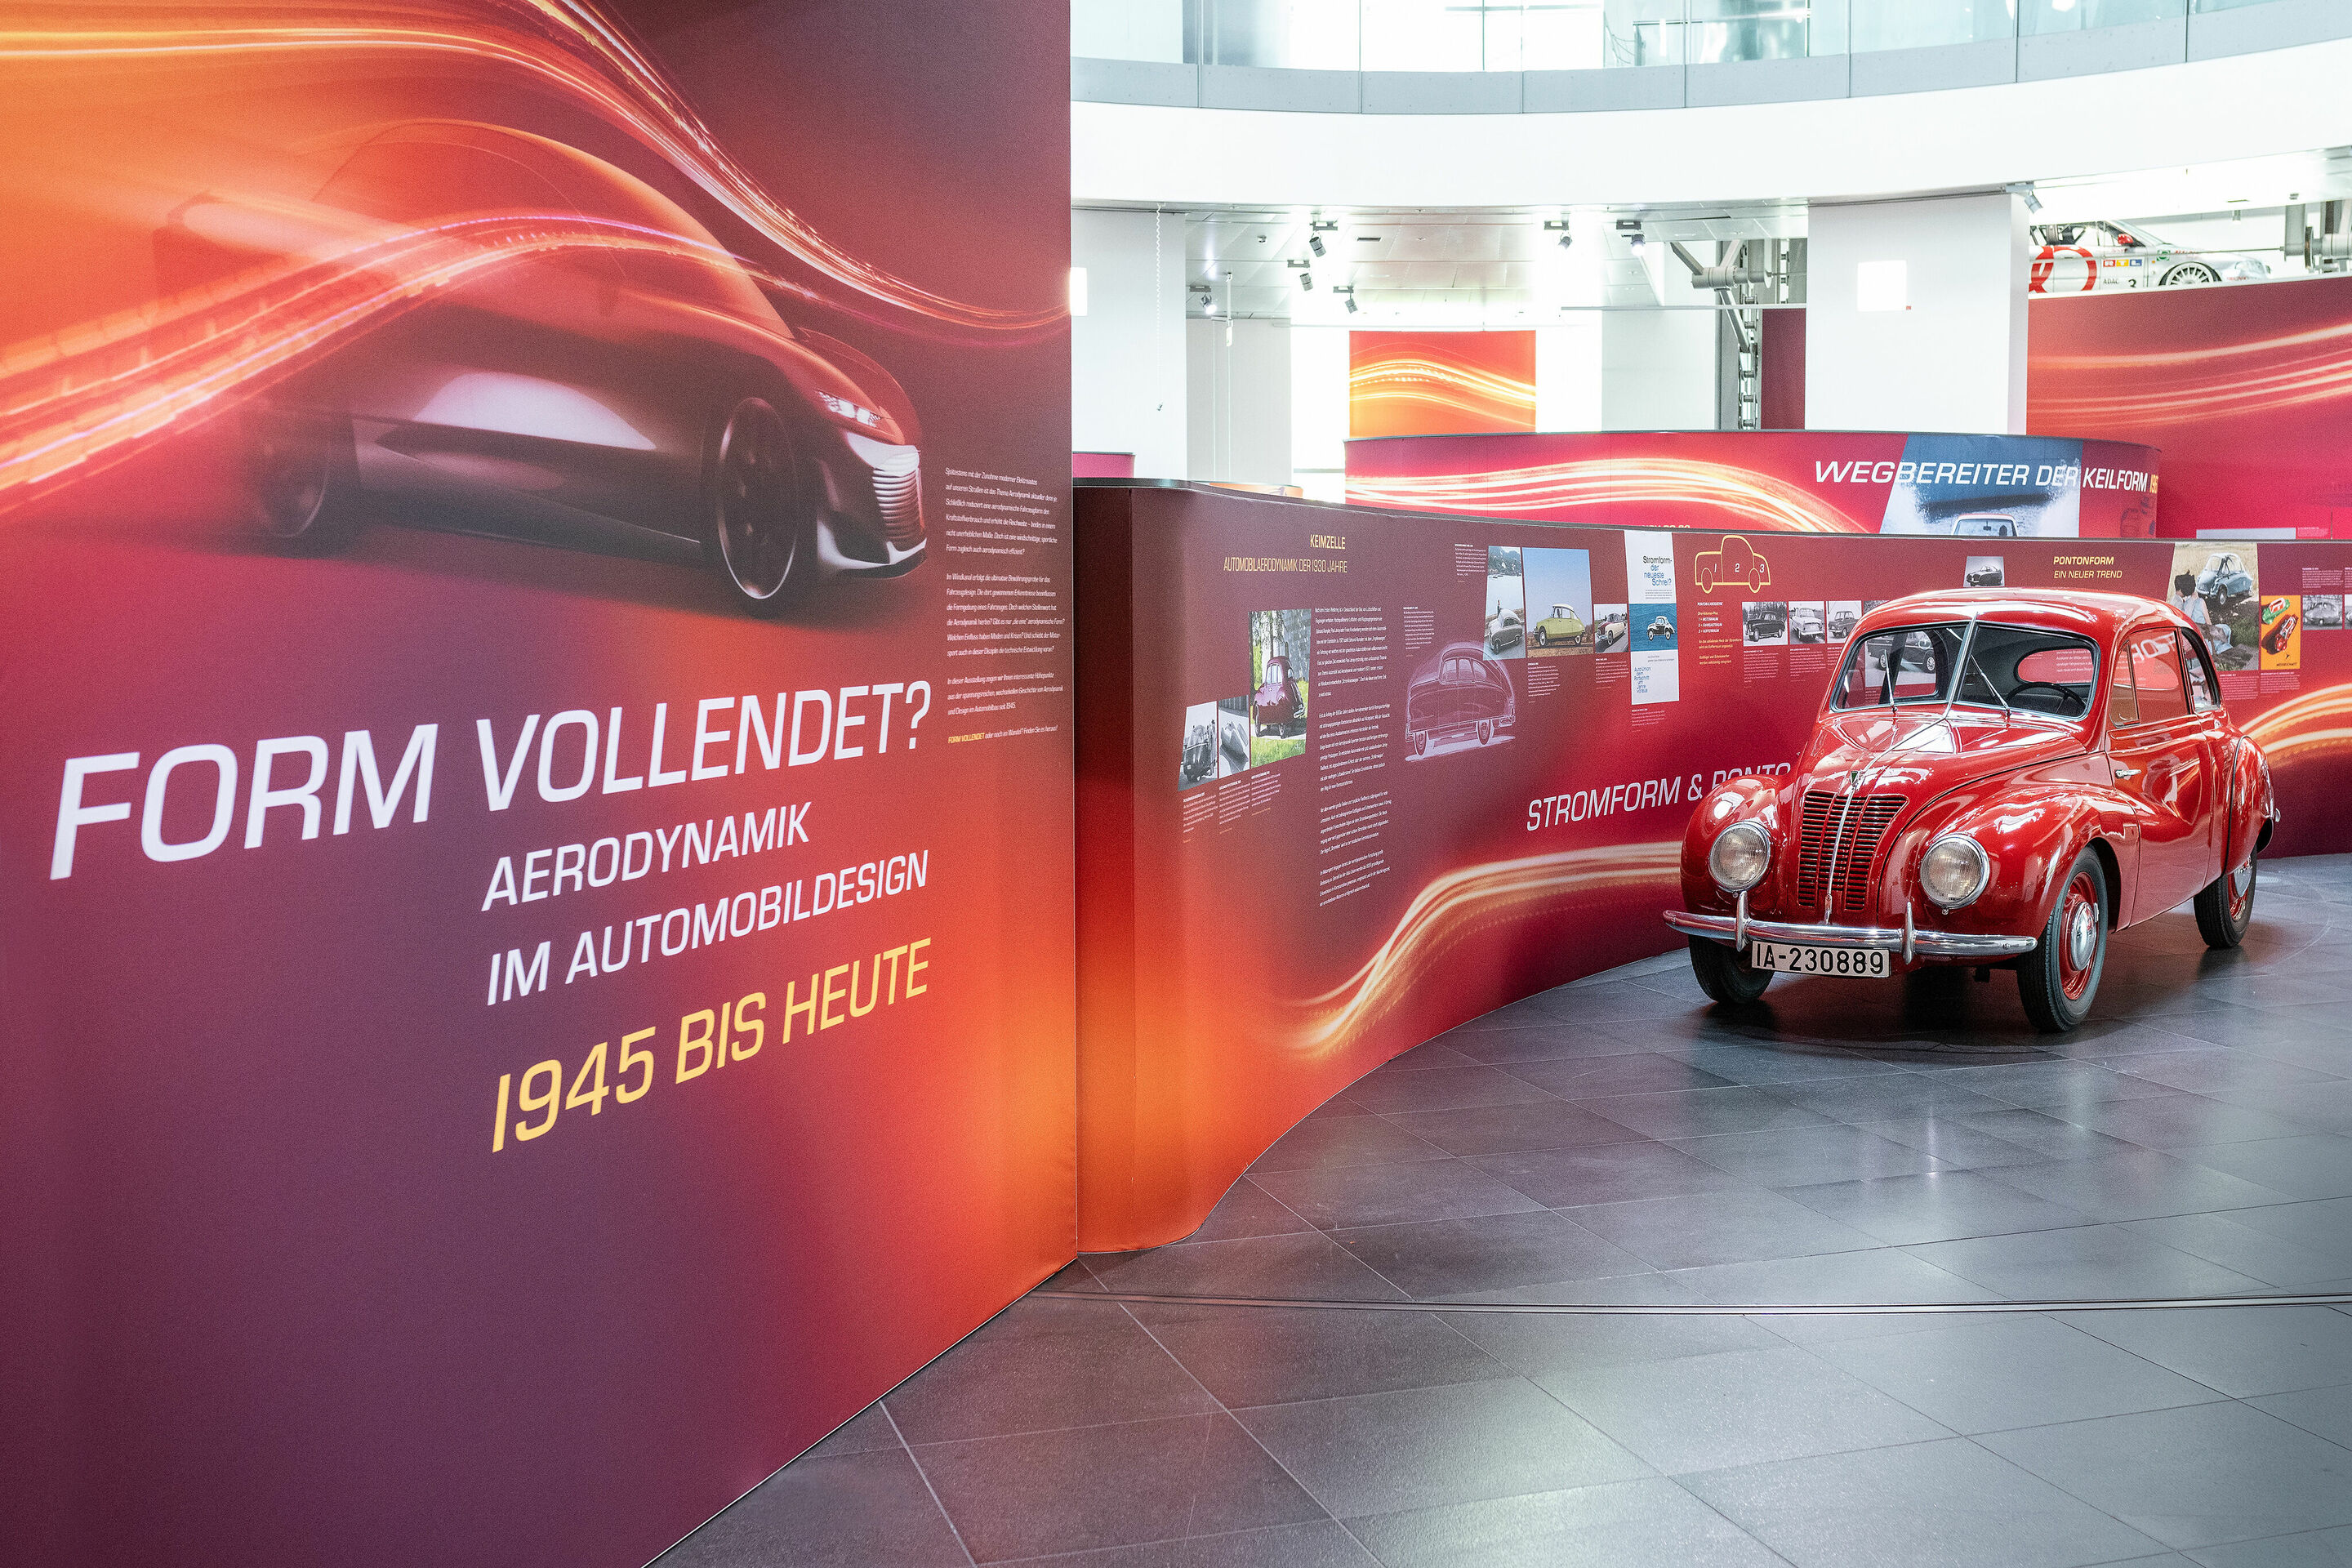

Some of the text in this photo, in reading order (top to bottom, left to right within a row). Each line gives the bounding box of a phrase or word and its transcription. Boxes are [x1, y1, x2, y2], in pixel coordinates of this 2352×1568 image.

[1815, 461, 2027, 486] WEGBEREITER
[2035, 464, 2079, 488] DER
[2082, 467, 2148, 492] KEILFORM
[1310, 534, 1346, 550] KEIMZELLE
[1223, 556, 1298, 572] AUTOMOBILAERODYNAMIK
[1298, 559, 1311, 572] DER
[1327, 560, 1348, 573] JAHRE
[1735, 563, 1740, 572] 2
[1759, 564, 1765, 573] 3
[2053, 556, 2114, 565] PONTONFORM
[1651, 578, 1672, 586] Schrei?
[2054, 570, 2123, 579] EIN NEUER TREND
[50, 680, 932, 880] FORM VOLLENDET?
[1526, 776, 1682, 831] STROMFORM
[1687, 773, 1703, 801] &
[481, 802, 810, 911] AERODYNAMIK
[487, 850, 929, 1006] IM AUTOMOBILDESIGN
[1756, 943, 1884, 974] IA-230889
[491, 938, 931, 1153] 1945 BIS HEUTE
